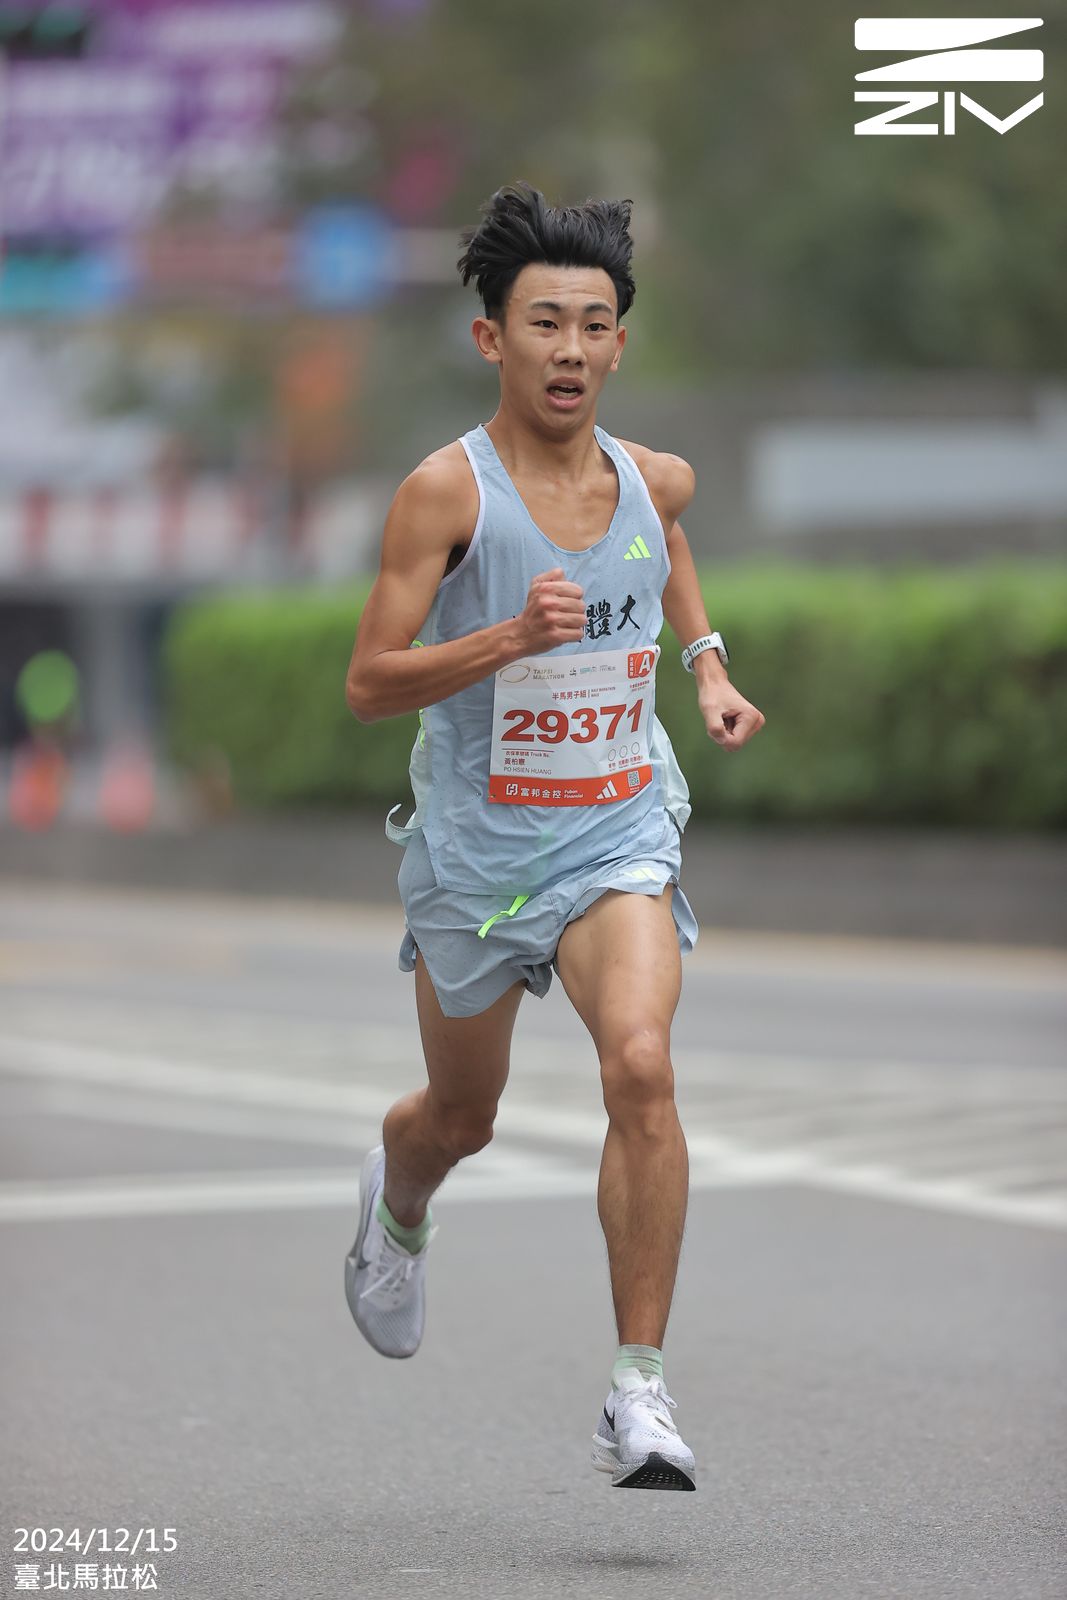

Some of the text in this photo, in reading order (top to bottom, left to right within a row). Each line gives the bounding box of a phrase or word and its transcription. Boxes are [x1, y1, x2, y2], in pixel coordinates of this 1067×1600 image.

[639, 653, 650, 675] A
[552, 689, 587, 700] 半馬男子組
[501, 698, 644, 744] 29371
[512, 766, 530, 774] HSIEN
[531, 768, 552, 776] HUANG
[520, 787, 562, 799] 富邦金控
